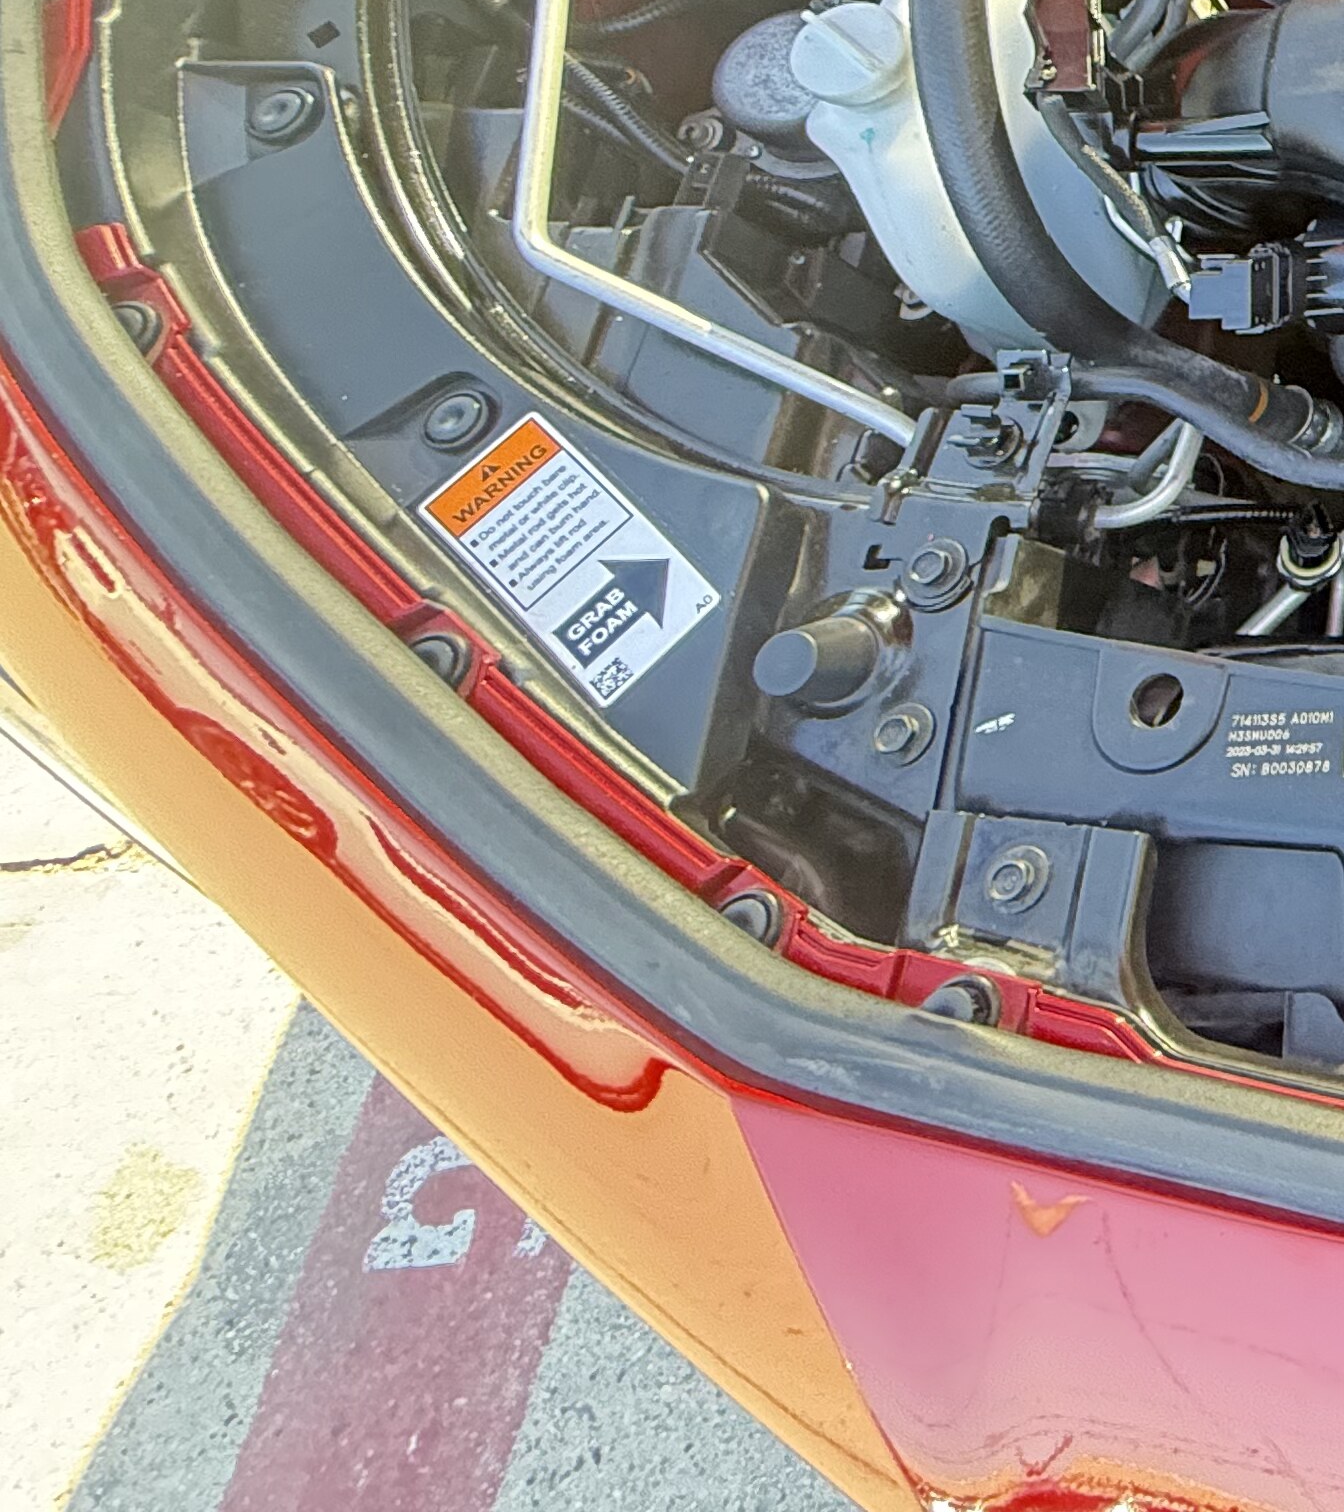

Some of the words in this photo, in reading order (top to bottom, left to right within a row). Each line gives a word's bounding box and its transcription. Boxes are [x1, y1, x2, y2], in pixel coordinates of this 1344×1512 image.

[452, 444, 547, 523] WARNING
[478, 526, 496, 541] Do
[496, 509, 515, 527] not
[513, 485, 543, 511] touch
[541, 465, 566, 487] bare
[488, 523, 518, 552] metal
[518, 513, 530, 526] or
[530, 491, 559, 515] white
[557, 474, 581, 491] clip.
[498, 533, 526, 561] Metal
[528, 518, 546, 536] rod
[546, 499, 570, 521] gets
[567, 483, 588, 500] hot
[508, 550, 530, 571] and
[529, 534, 550, 553] can
[548, 513, 574, 535] burn
[572, 489, 602, 514] hand.
[518, 548, 555, 581] Always
[553, 535, 570, 549] lift
[568, 518, 587, 536] rod
[527, 565, 557, 591] using
[554, 541, 583, 566] foam
[582, 520, 610, 542] area.
[566, 588, 626, 641] GRAB
[577, 600, 639, 656] FOAM
[1230, 761, 1258, 778] SN:
